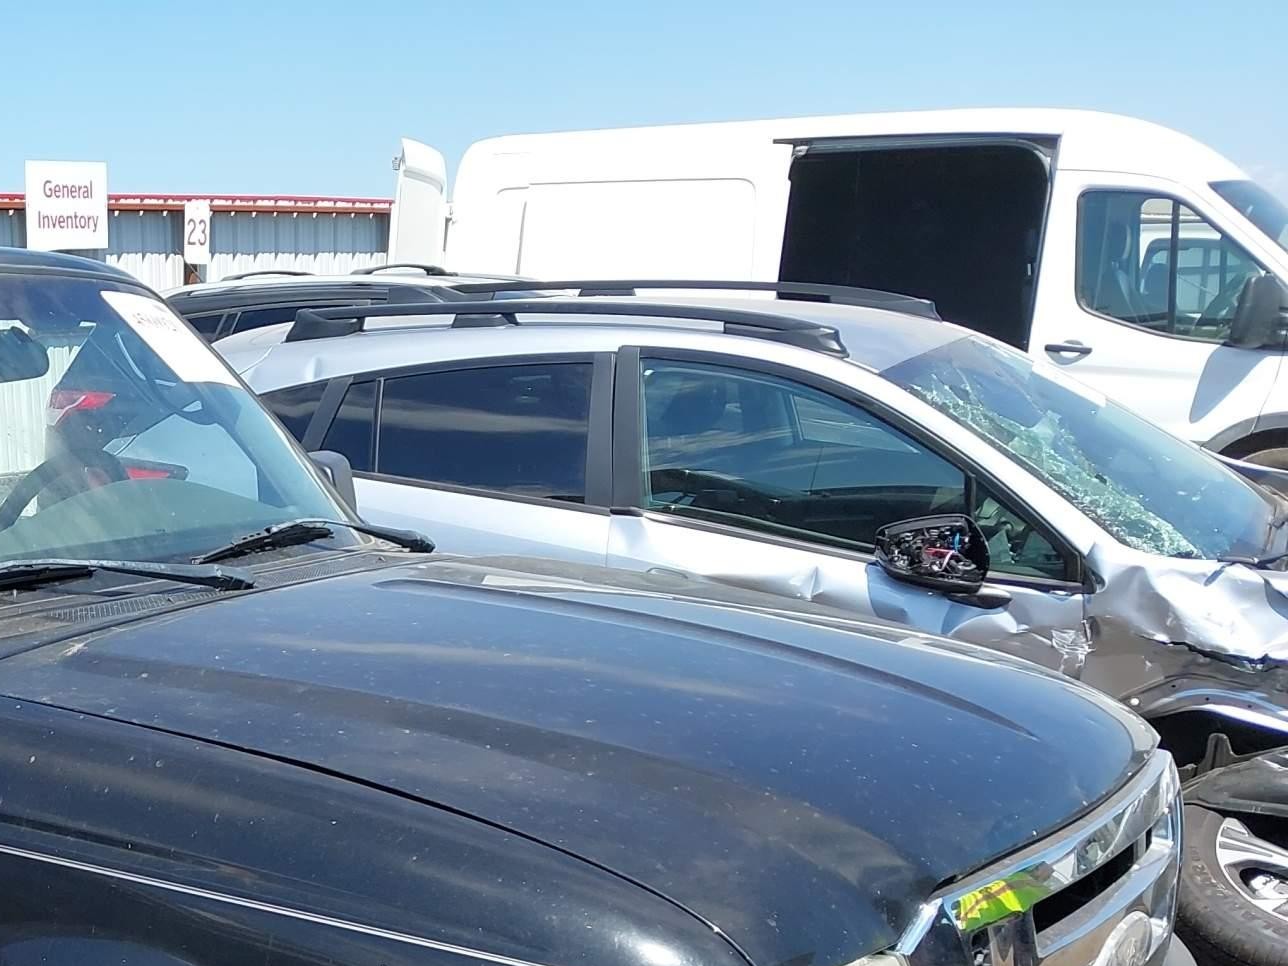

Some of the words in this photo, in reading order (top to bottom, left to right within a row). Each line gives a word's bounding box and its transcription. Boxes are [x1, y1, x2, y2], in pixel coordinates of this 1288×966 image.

[43, 179, 94, 200] General
[37, 210, 100, 233] Inventory
[187, 219, 208, 247] 23
